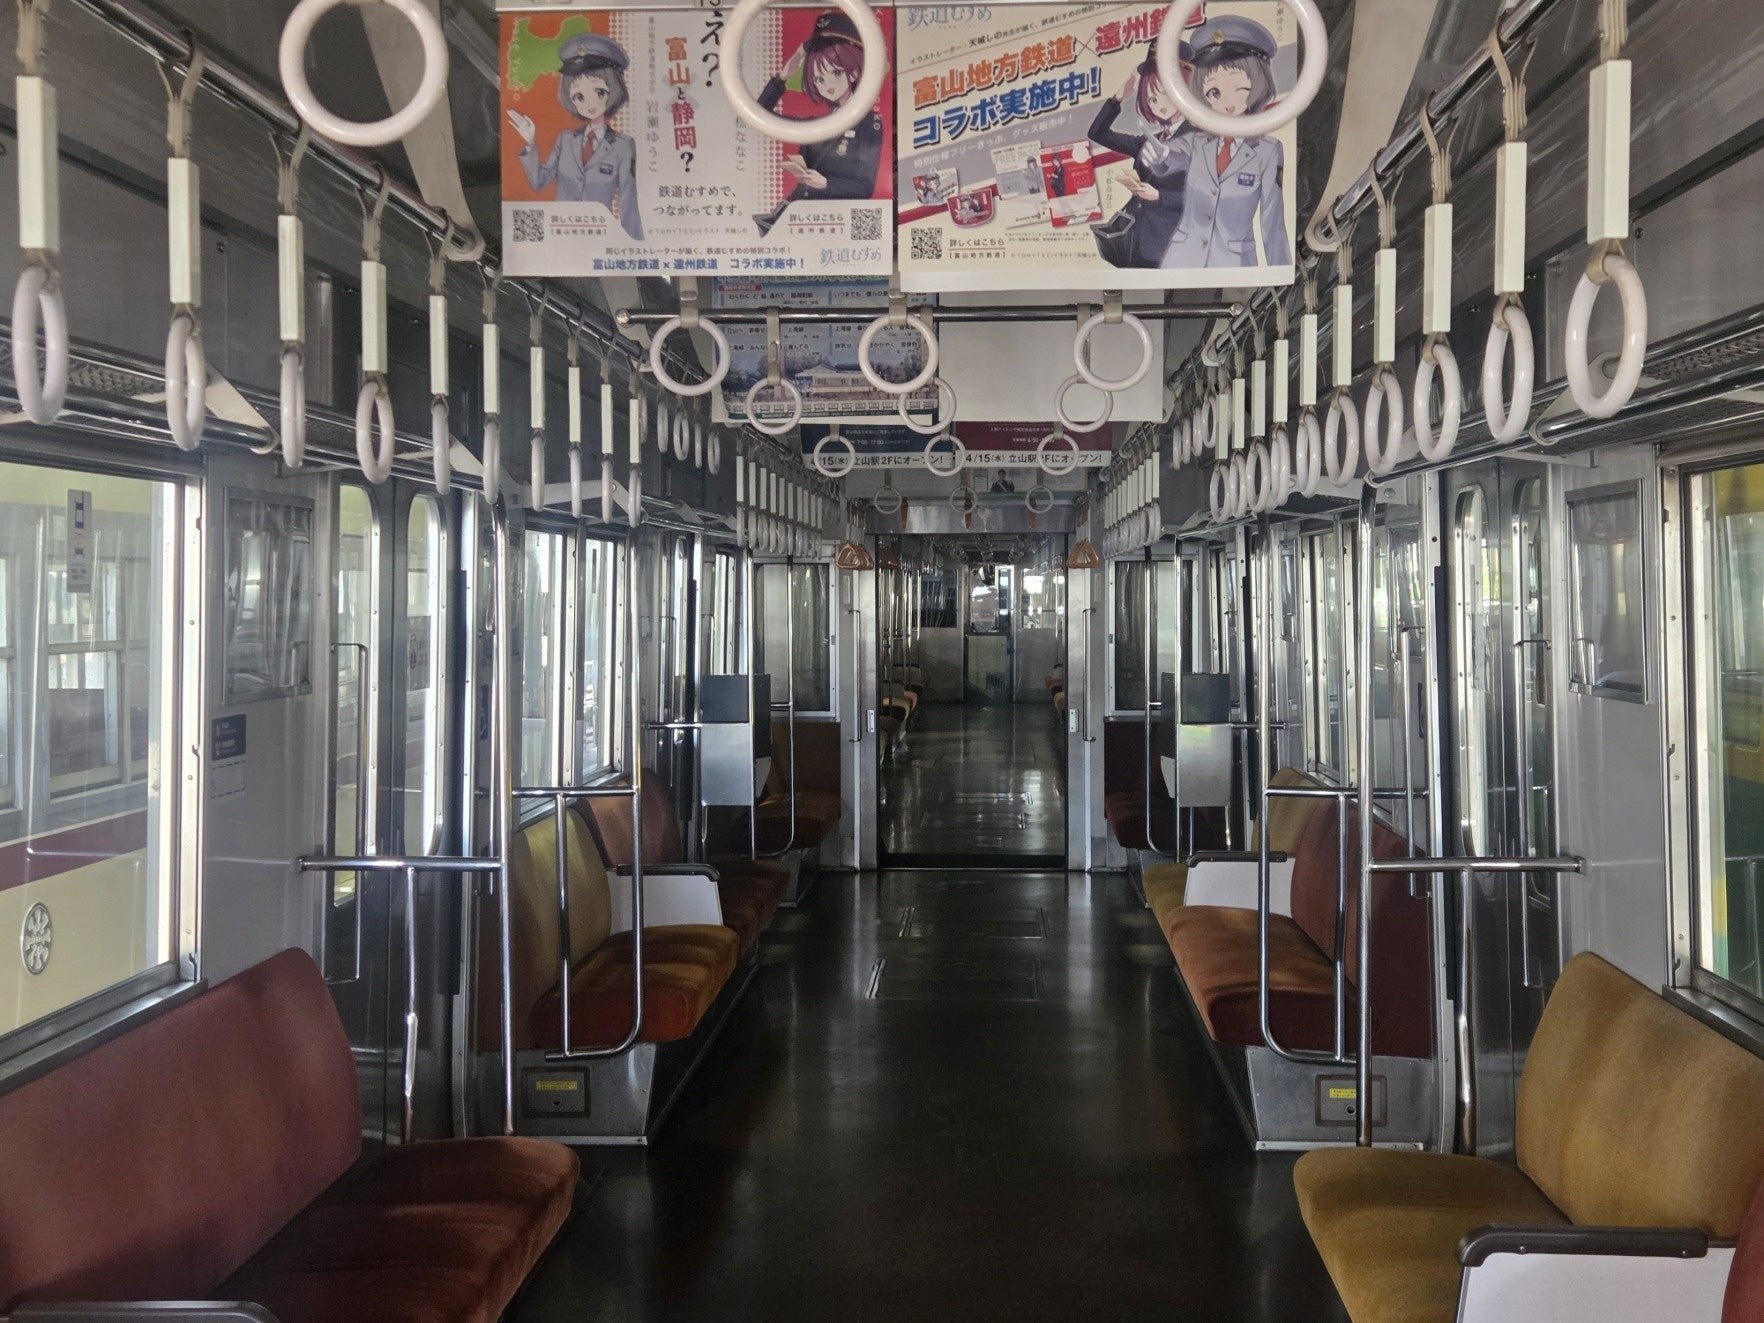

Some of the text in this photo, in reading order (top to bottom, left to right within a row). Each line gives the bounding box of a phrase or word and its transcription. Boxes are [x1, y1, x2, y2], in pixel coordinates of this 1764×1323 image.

[700, 0, 724, 87] え？
[665, 36, 697, 173] 富山と静岡？
[913, 66, 1101, 148] コラボ実施中！
[658, 185, 737, 198] 鉄道むすめで、
[653, 203, 743, 217] つながってます。
[551, 214, 606, 223] 詳しくはこちら
[789, 213, 844, 222] 詳しくはこちら
[949, 238, 1006, 247] 詳しくはこちら
[820, 246, 882, 267] 鉄道むすめ
[1008, 452, 1102, 464] 立山駅Fにオプン!
